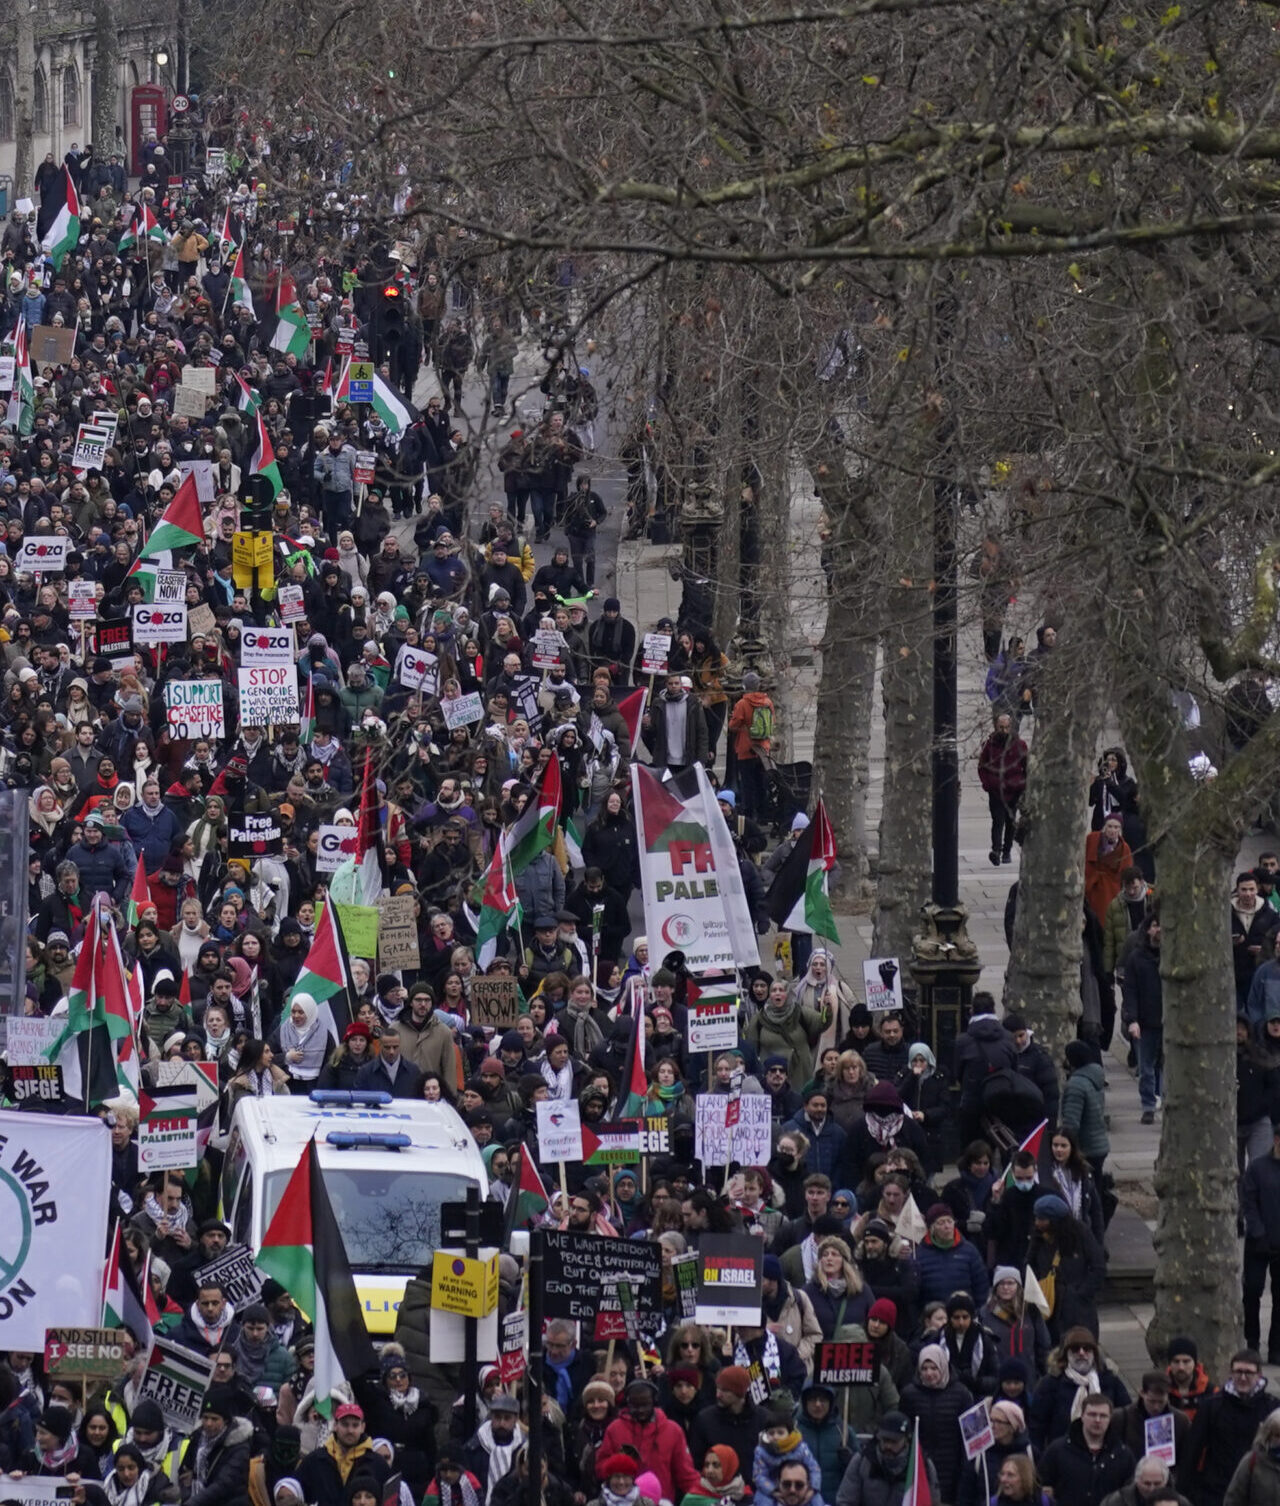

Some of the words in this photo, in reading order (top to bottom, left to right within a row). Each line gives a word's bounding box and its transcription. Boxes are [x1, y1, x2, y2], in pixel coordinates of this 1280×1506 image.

[175, 99, 188, 108] 20
[76, 442, 105, 457] FREE
[99, 627, 130, 645] FREE
[249, 668, 287, 685] STOP
[173, 684, 222, 705] SUPPORT
[247, 685, 293, 698] GENOCIDE
[167, 704, 223, 724] CEASEFIRE
[249, 706, 300, 716] OCCUPATION
[168, 722, 189, 740] DO
[230, 829, 281, 843] Palestine
[245, 826, 273, 840] Free
[383, 943, 411, 956] GAZA
[472, 981, 514, 993] CEASEFIRE
[696, 1003, 731, 1018] FREE
[690, 1016, 736, 1027] PALESTINE
[36, 1067, 58, 1080] THE
[13, 1079, 61, 1100] SIEGE
[148, 1116, 190, 1134] FREE
[647, 1117, 669, 1131] THE
[140, 1132, 196, 1145] PALESTINE
[10, 1148, 58, 1227] WAR
[547, 1231, 570, 1249] WE
[574, 1237, 603, 1253] WANT
[560, 1251, 594, 1267] PEACE
[563, 1265, 587, 1279] BUT
[704, 1269, 718, 1282] ON
[720, 1270, 756, 1283] ISRAEL
[438, 1282, 478, 1299] WARNING
[545, 1280, 573, 1296] END
[575, 1283, 600, 1297] THE
[446, 1293, 469, 1305] Parking
[570, 1300, 595, 1318] END
[50, 1329, 81, 1344] AND
[83, 1330, 118, 1345] STILL
[49, 1343, 61, 1359] I
[66, 1343, 95, 1359] SEE
[97, 1344, 122, 1359] NO
[820, 1343, 874, 1371] FREE
[820, 1369, 873, 1384] PALESTINE
[140, 1371, 203, 1407] FREE
